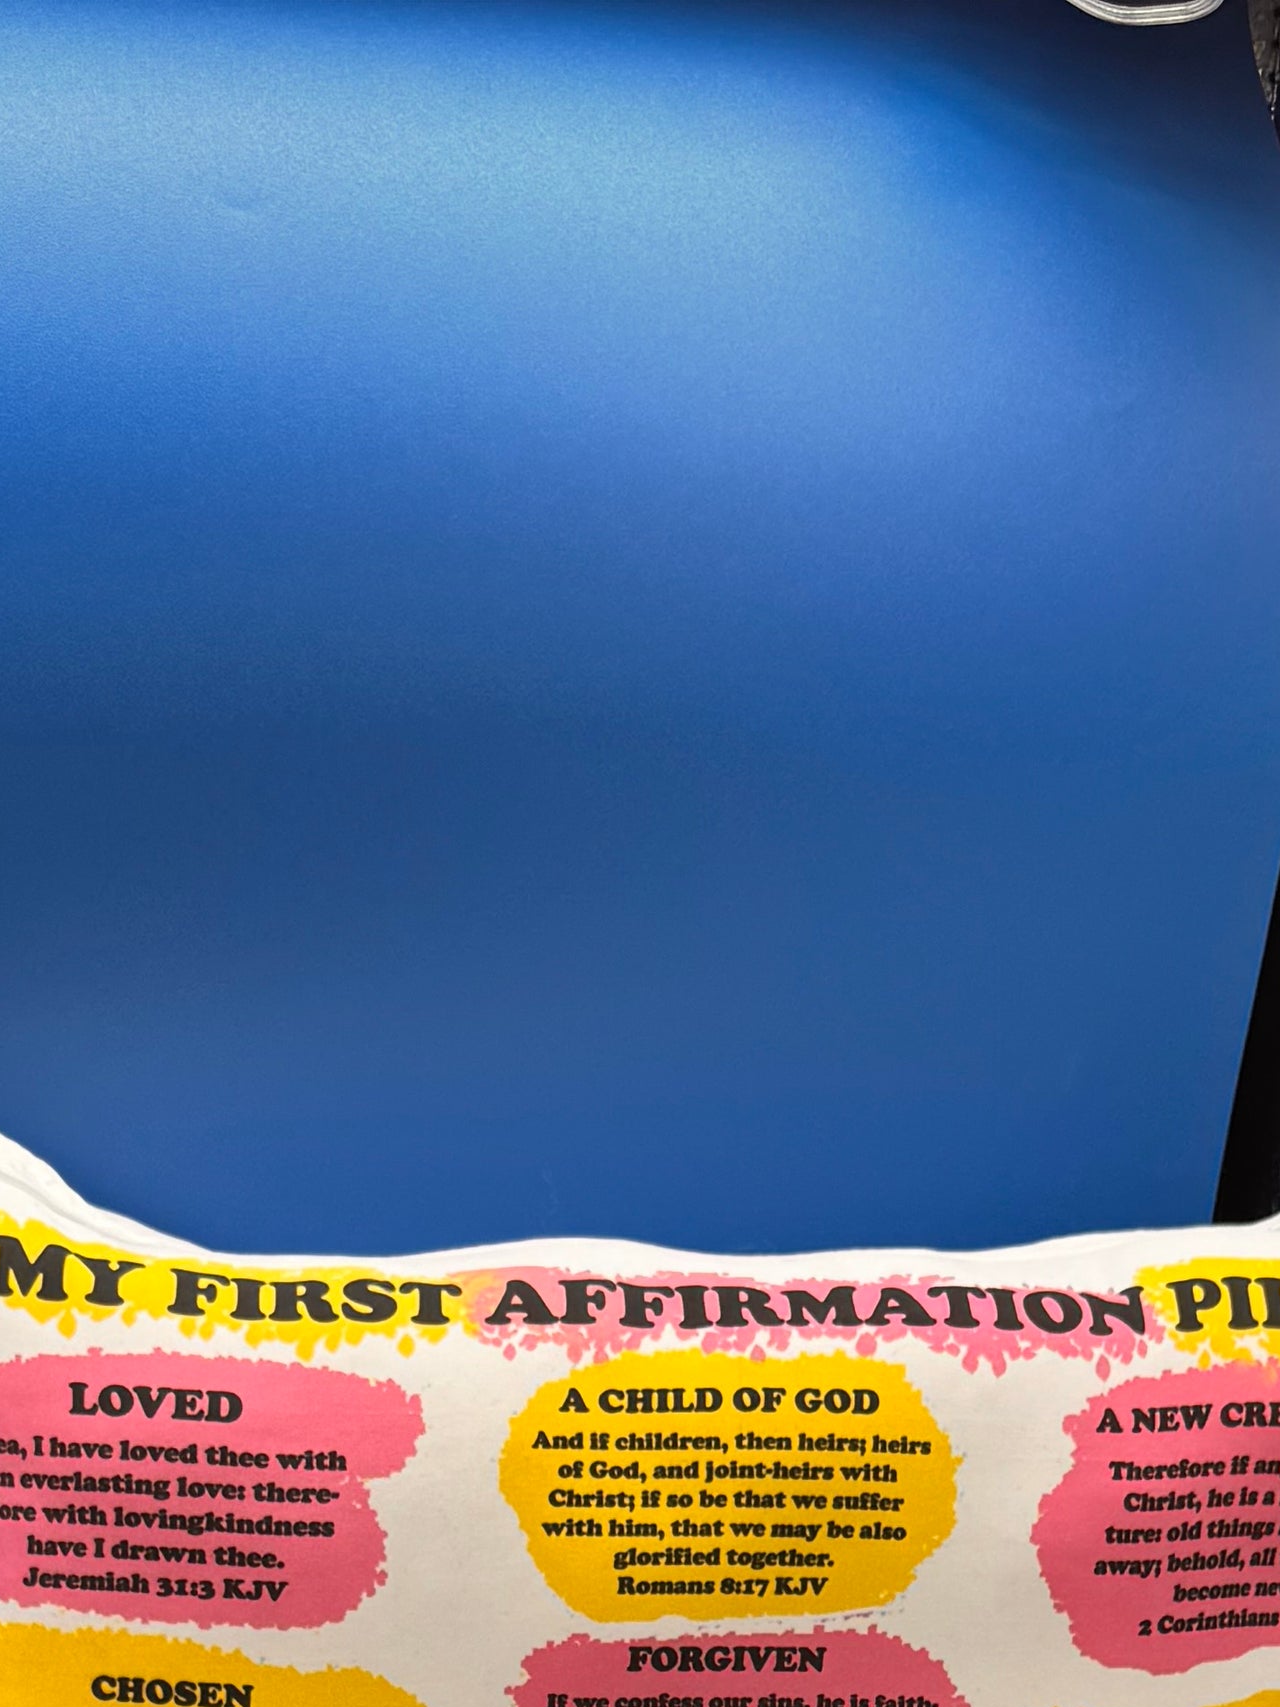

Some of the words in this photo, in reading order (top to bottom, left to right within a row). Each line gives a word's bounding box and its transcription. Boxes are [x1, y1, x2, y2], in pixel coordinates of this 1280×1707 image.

[166, 1269, 462, 1326] FIRST
[482, 1278, 1146, 1337] AFFIRMATION
[69, 1381, 244, 1424] LOVED
[559, 1388, 589, 1413] A
[597, 1388, 724, 1414] CHILD
[732, 1387, 786, 1412] OF
[794, 1388, 881, 1414] GOD
[1095, 1407, 1124, 1434] A
[1131, 1403, 1213, 1434] NEW
[33, 1435, 45, 1455] I
[49, 1437, 114, 1459] have
[120, 1440, 198, 1464] loved
[205, 1446, 270, 1469] thee
[275, 1451, 348, 1471] with
[19, 1471, 171, 1501] everlasting
[177, 1477, 246, 1500] love:
[252, 1482, 340, 1504] there-
[41, 1503, 108, 1526] with
[114, 1507, 335, 1537] lovingkindness
[26, 1535, 88, 1557] have
[94, 1538, 106, 1558] I
[110, 1540, 207, 1565] drawn
[213, 1546, 286, 1569] thee.
[22, 1567, 151, 1594] Jeremiah
[155, 1577, 216, 1600] 31:3
[222, 1578, 289, 1602] KJV
[616, 1576, 716, 1595] Romans
[720, 1577, 770, 1597] 8:17
[774, 1577, 829, 1596] KJV
[1137, 1619, 1152, 1636] 2
[1157, 1610, 1280, 1634] Corinthians
[625, 1645, 828, 1673] FORGIVEN
